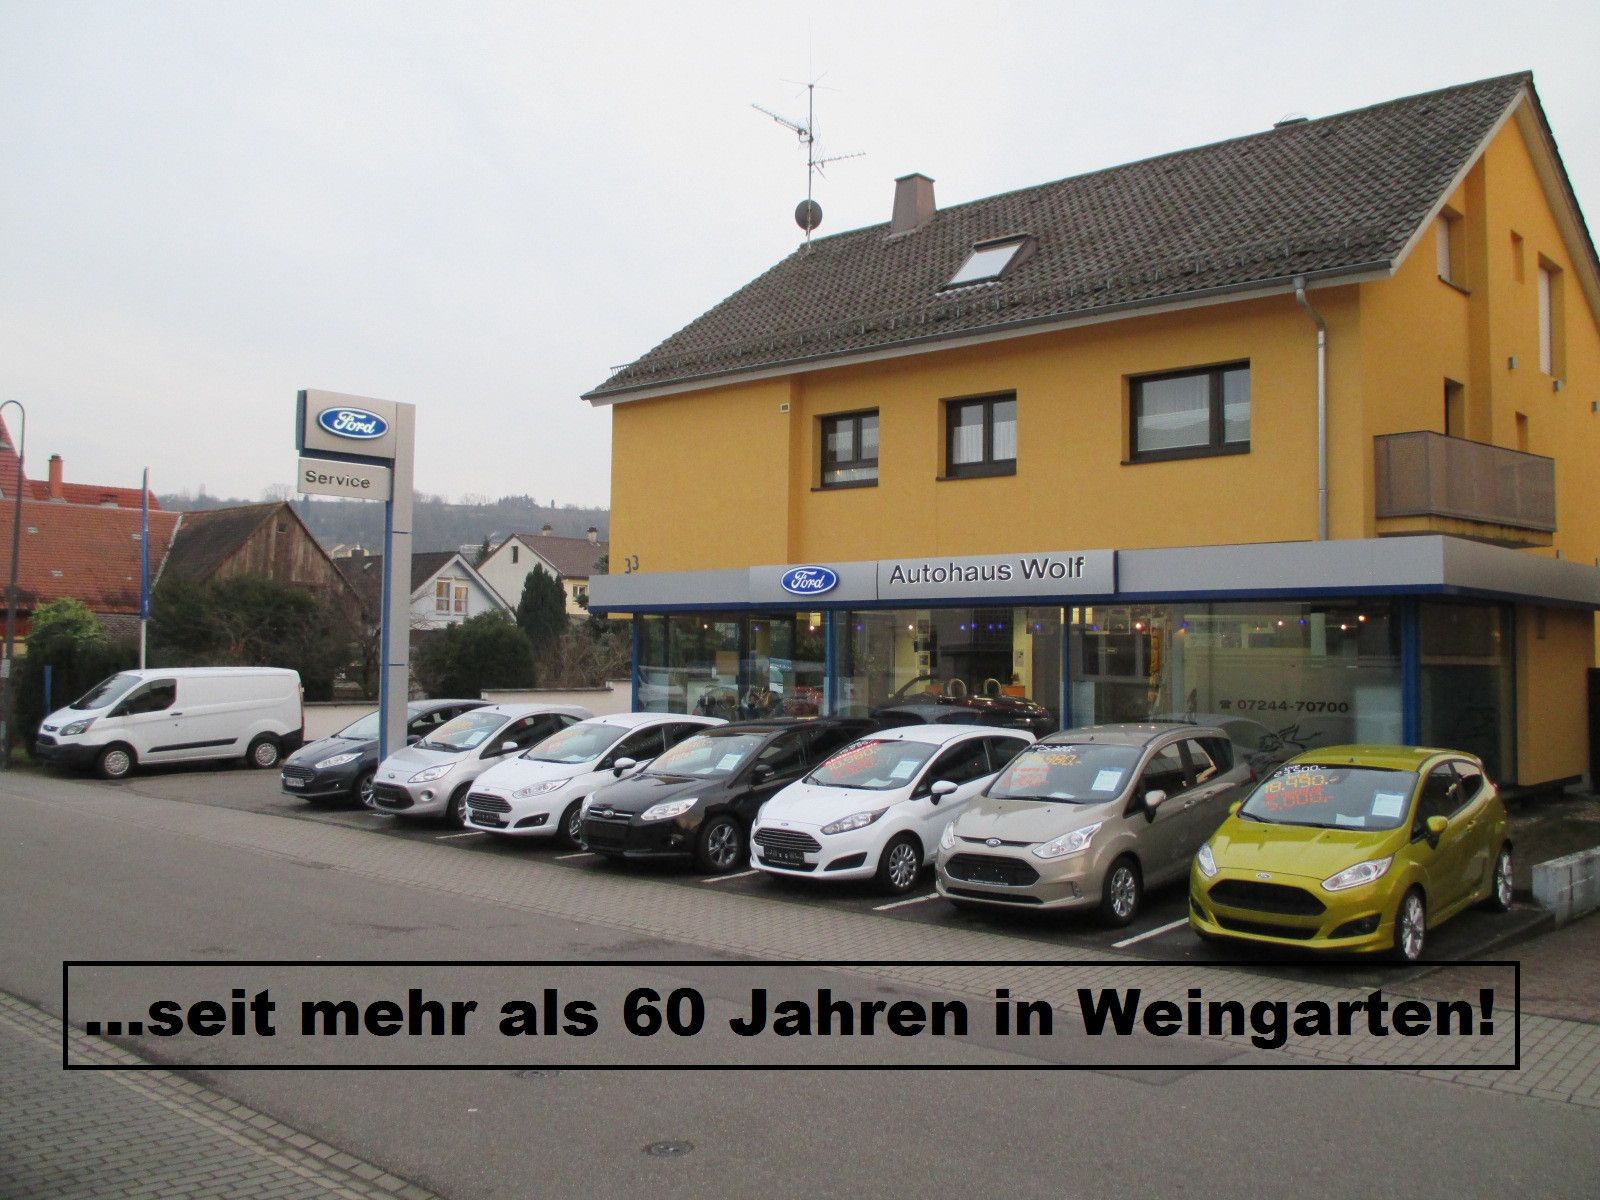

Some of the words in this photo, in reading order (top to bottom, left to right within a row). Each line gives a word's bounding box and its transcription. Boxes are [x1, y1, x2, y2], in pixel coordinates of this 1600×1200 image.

[333, 411, 376, 434] Ford
[305, 470, 371, 489] Service
[624, 554, 640, 574] 33
[889, 562, 1012, 585] Autohaus
[1020, 556, 1085, 580] Wolf
[791, 570, 826, 589] Ford
[1237, 699, 1349, 713] 07244-70700
